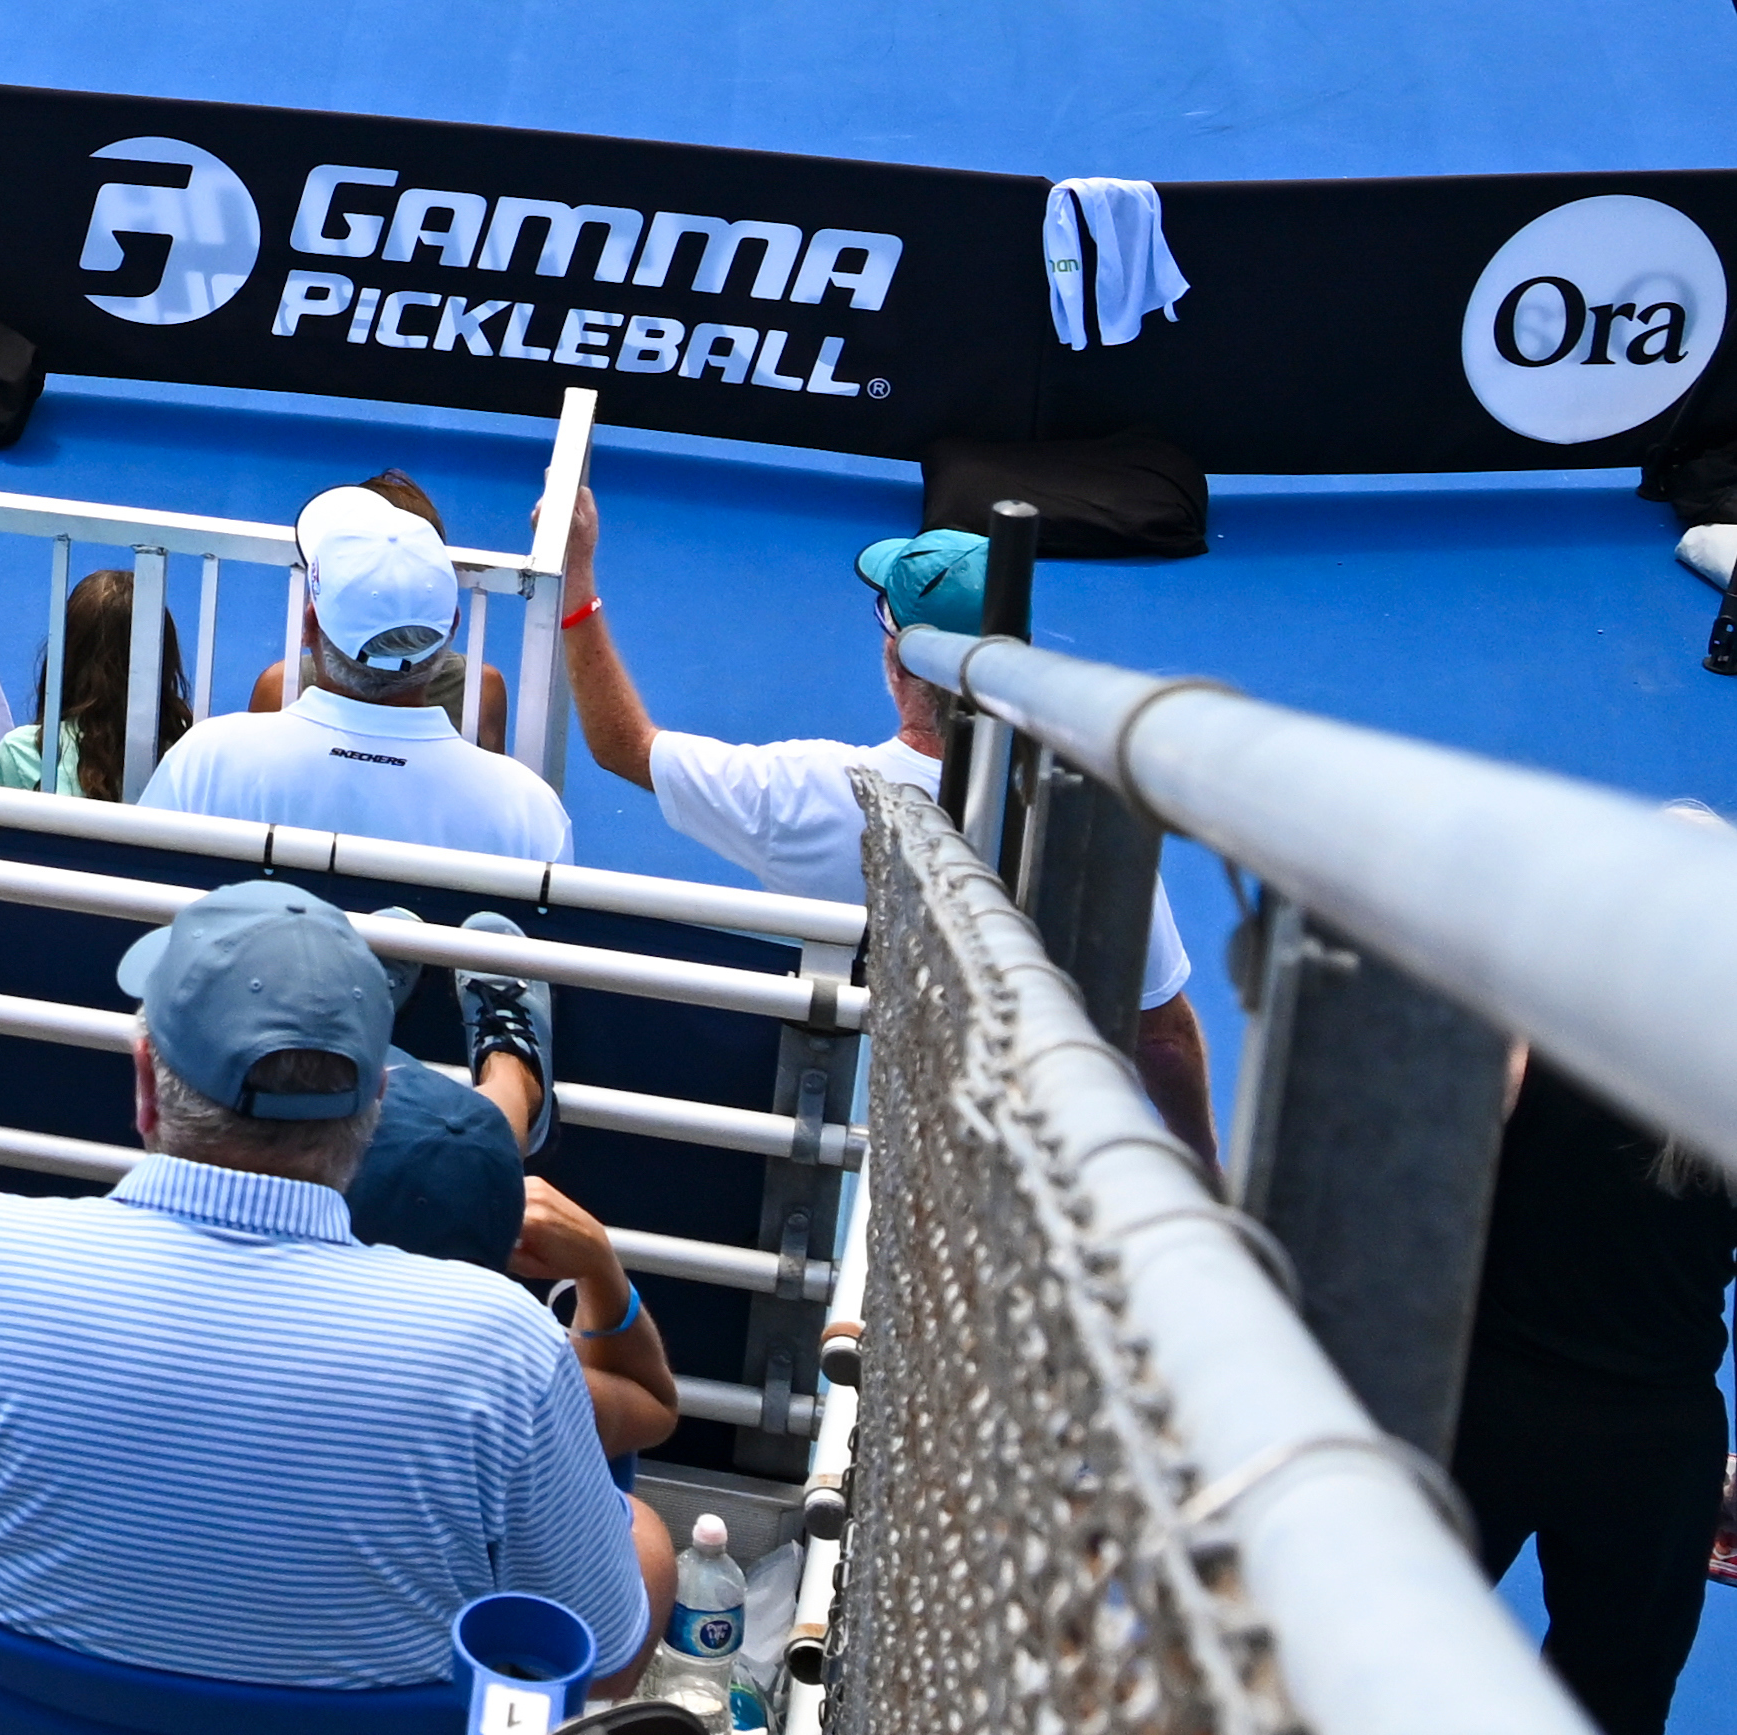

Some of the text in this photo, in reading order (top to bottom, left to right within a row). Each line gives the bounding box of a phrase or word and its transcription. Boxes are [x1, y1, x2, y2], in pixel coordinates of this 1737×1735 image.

[289, 163, 904, 311] GAMMA
[270, 268, 863, 398] PICKLEBALL
[1493, 275, 1690, 368] Ora
[329, 746, 408, 768] SKECHERS
